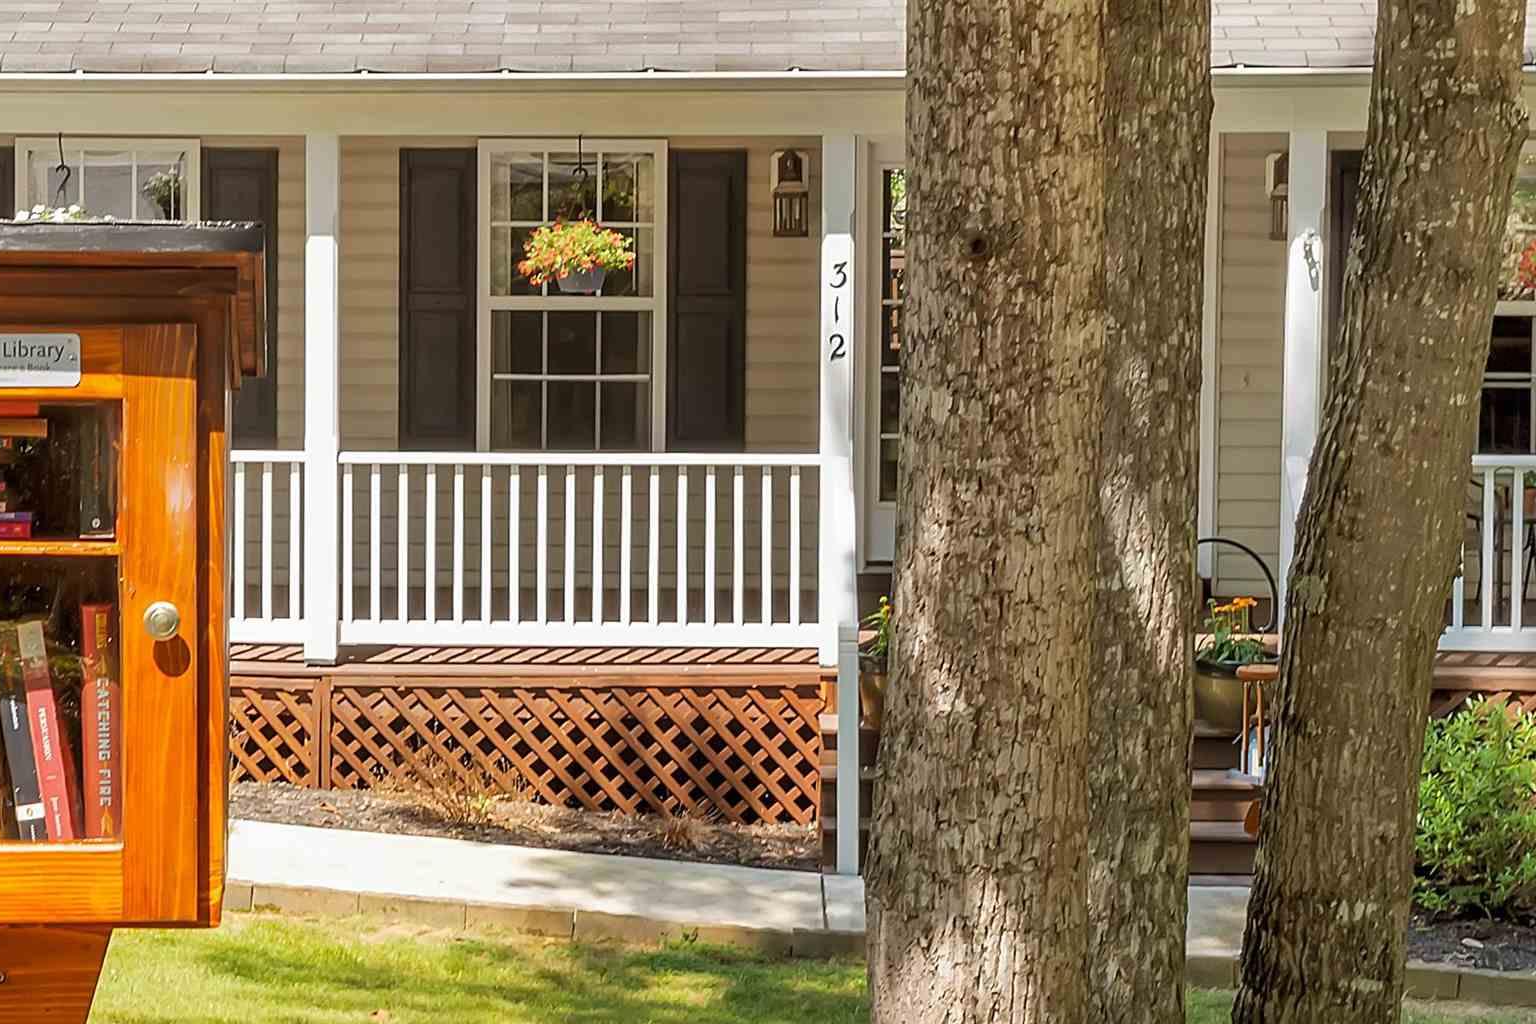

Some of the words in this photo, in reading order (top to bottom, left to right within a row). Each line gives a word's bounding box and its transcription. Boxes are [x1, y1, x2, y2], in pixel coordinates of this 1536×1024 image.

[829, 261, 848, 361] 312
[3, 340, 65, 361] Library
[96, 677, 112, 761] CATCHING
[99, 767, 112, 808] FIRE
